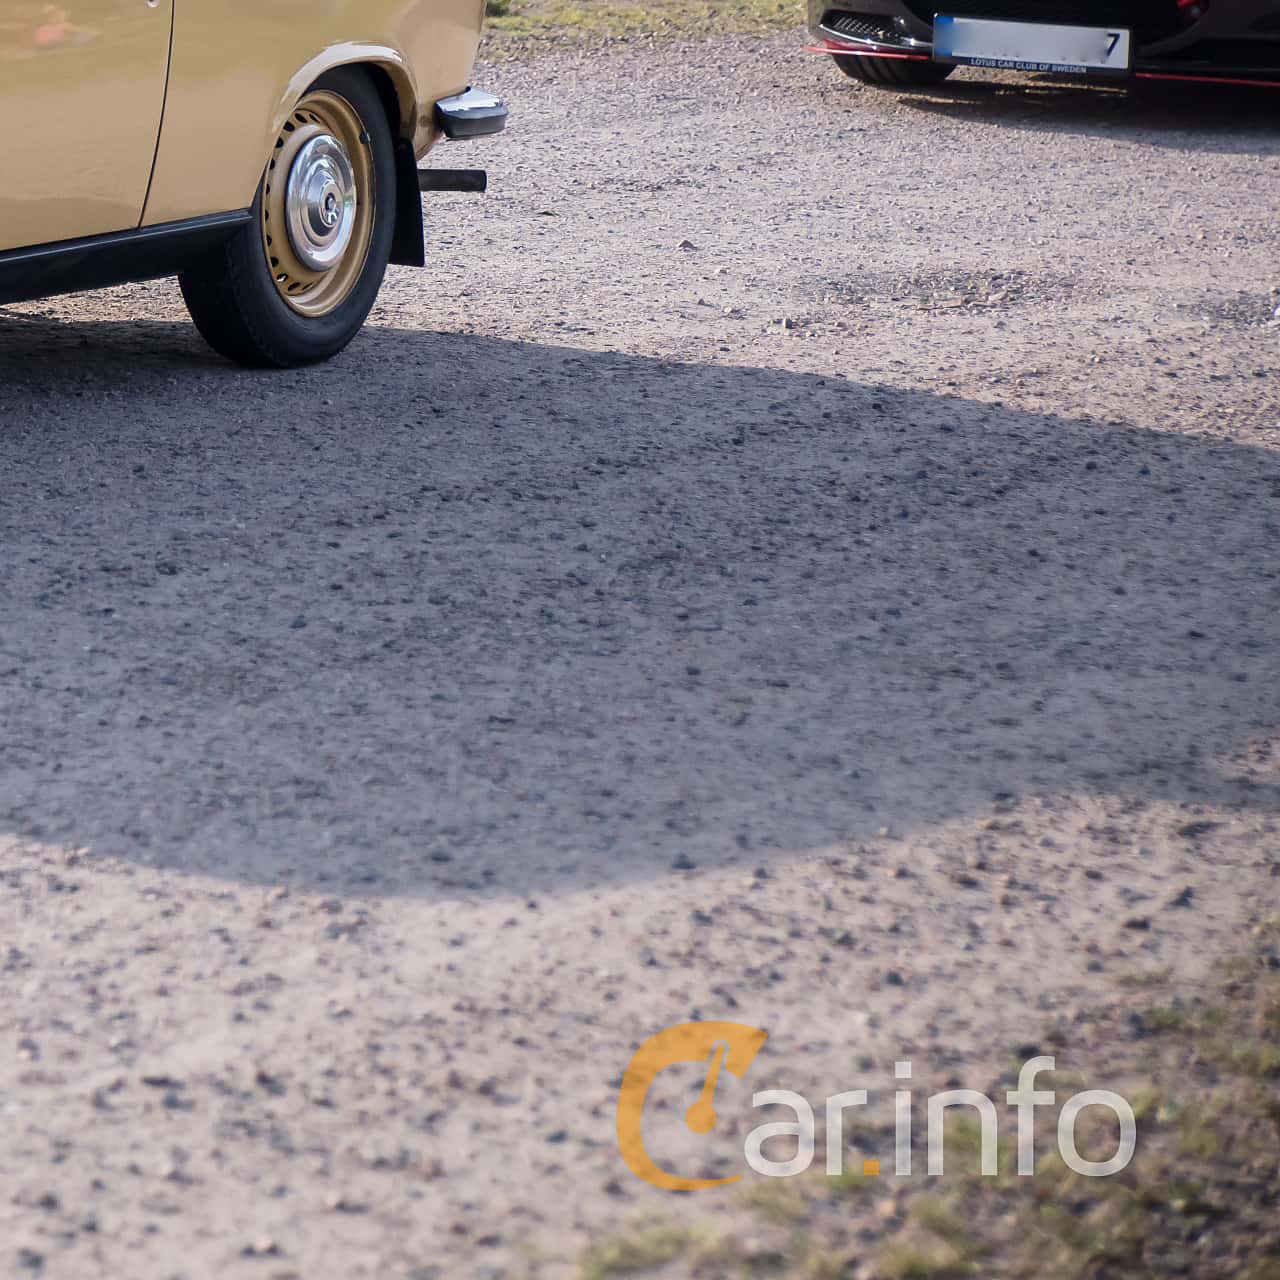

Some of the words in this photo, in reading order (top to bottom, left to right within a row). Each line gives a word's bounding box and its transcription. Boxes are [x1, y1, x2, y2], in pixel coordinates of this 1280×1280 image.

[971, 58, 996, 67] LOTUS
[998, 60, 1014, 68] CAR
[1016, 62, 1037, 70] CLUB
